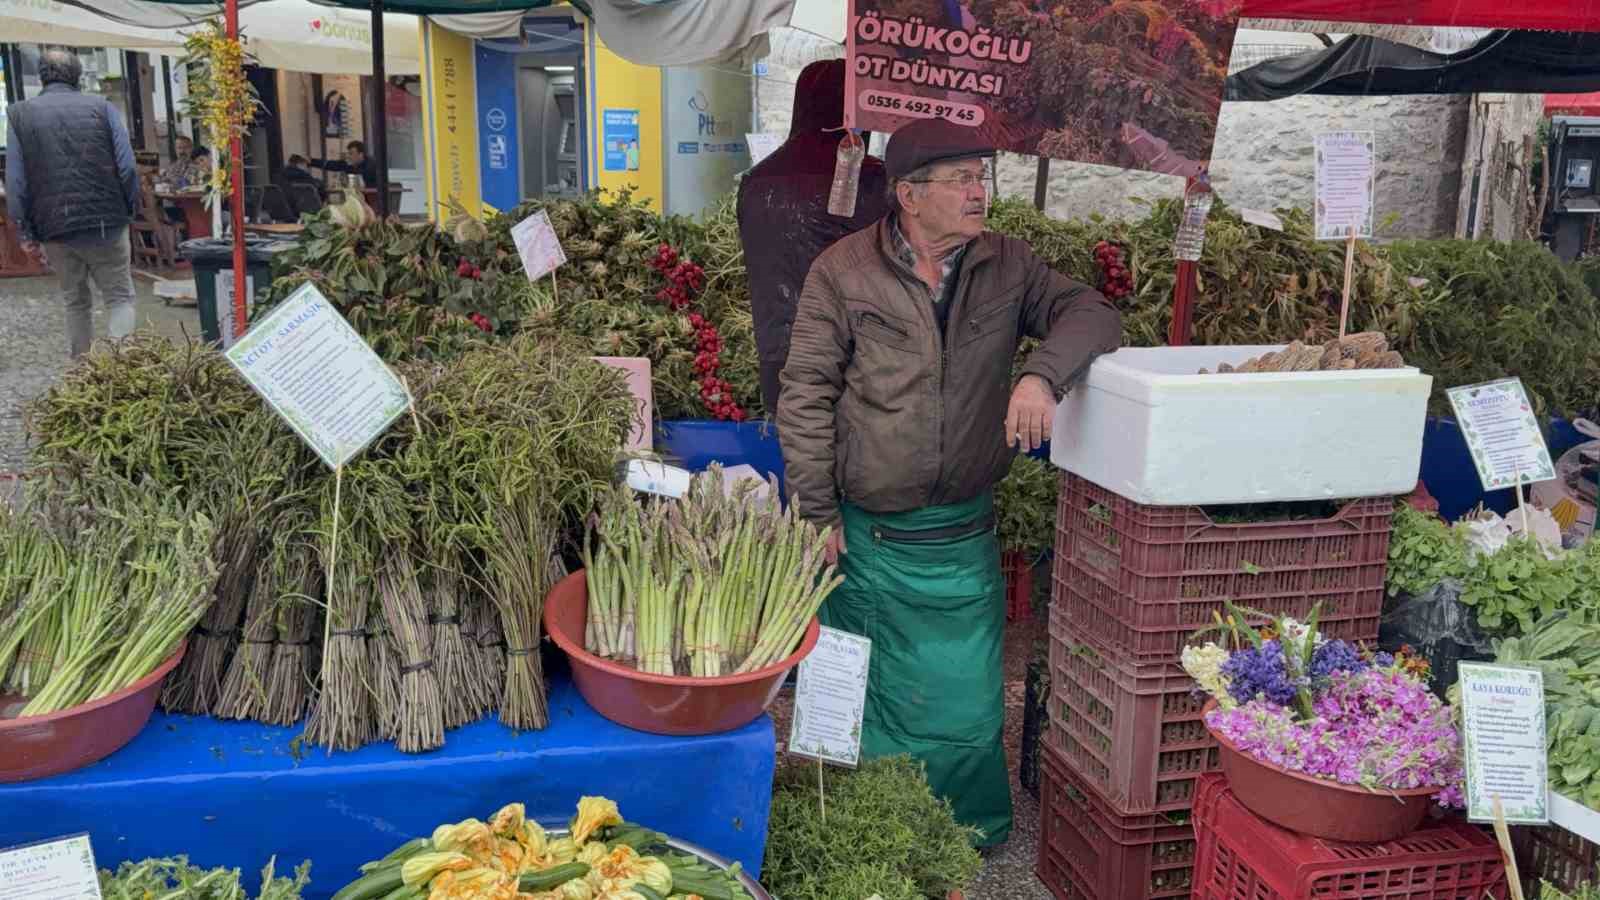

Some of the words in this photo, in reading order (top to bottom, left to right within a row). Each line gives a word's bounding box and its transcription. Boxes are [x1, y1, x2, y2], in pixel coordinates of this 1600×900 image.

[855, 56, 888, 77] OT
[892, 59, 1004, 96] DÜNYASI
[867, 94, 901, 110] 0536
[905, 99, 931, 115] 492
[935, 104, 953, 118] 97
[956, 108, 976, 121] 45
